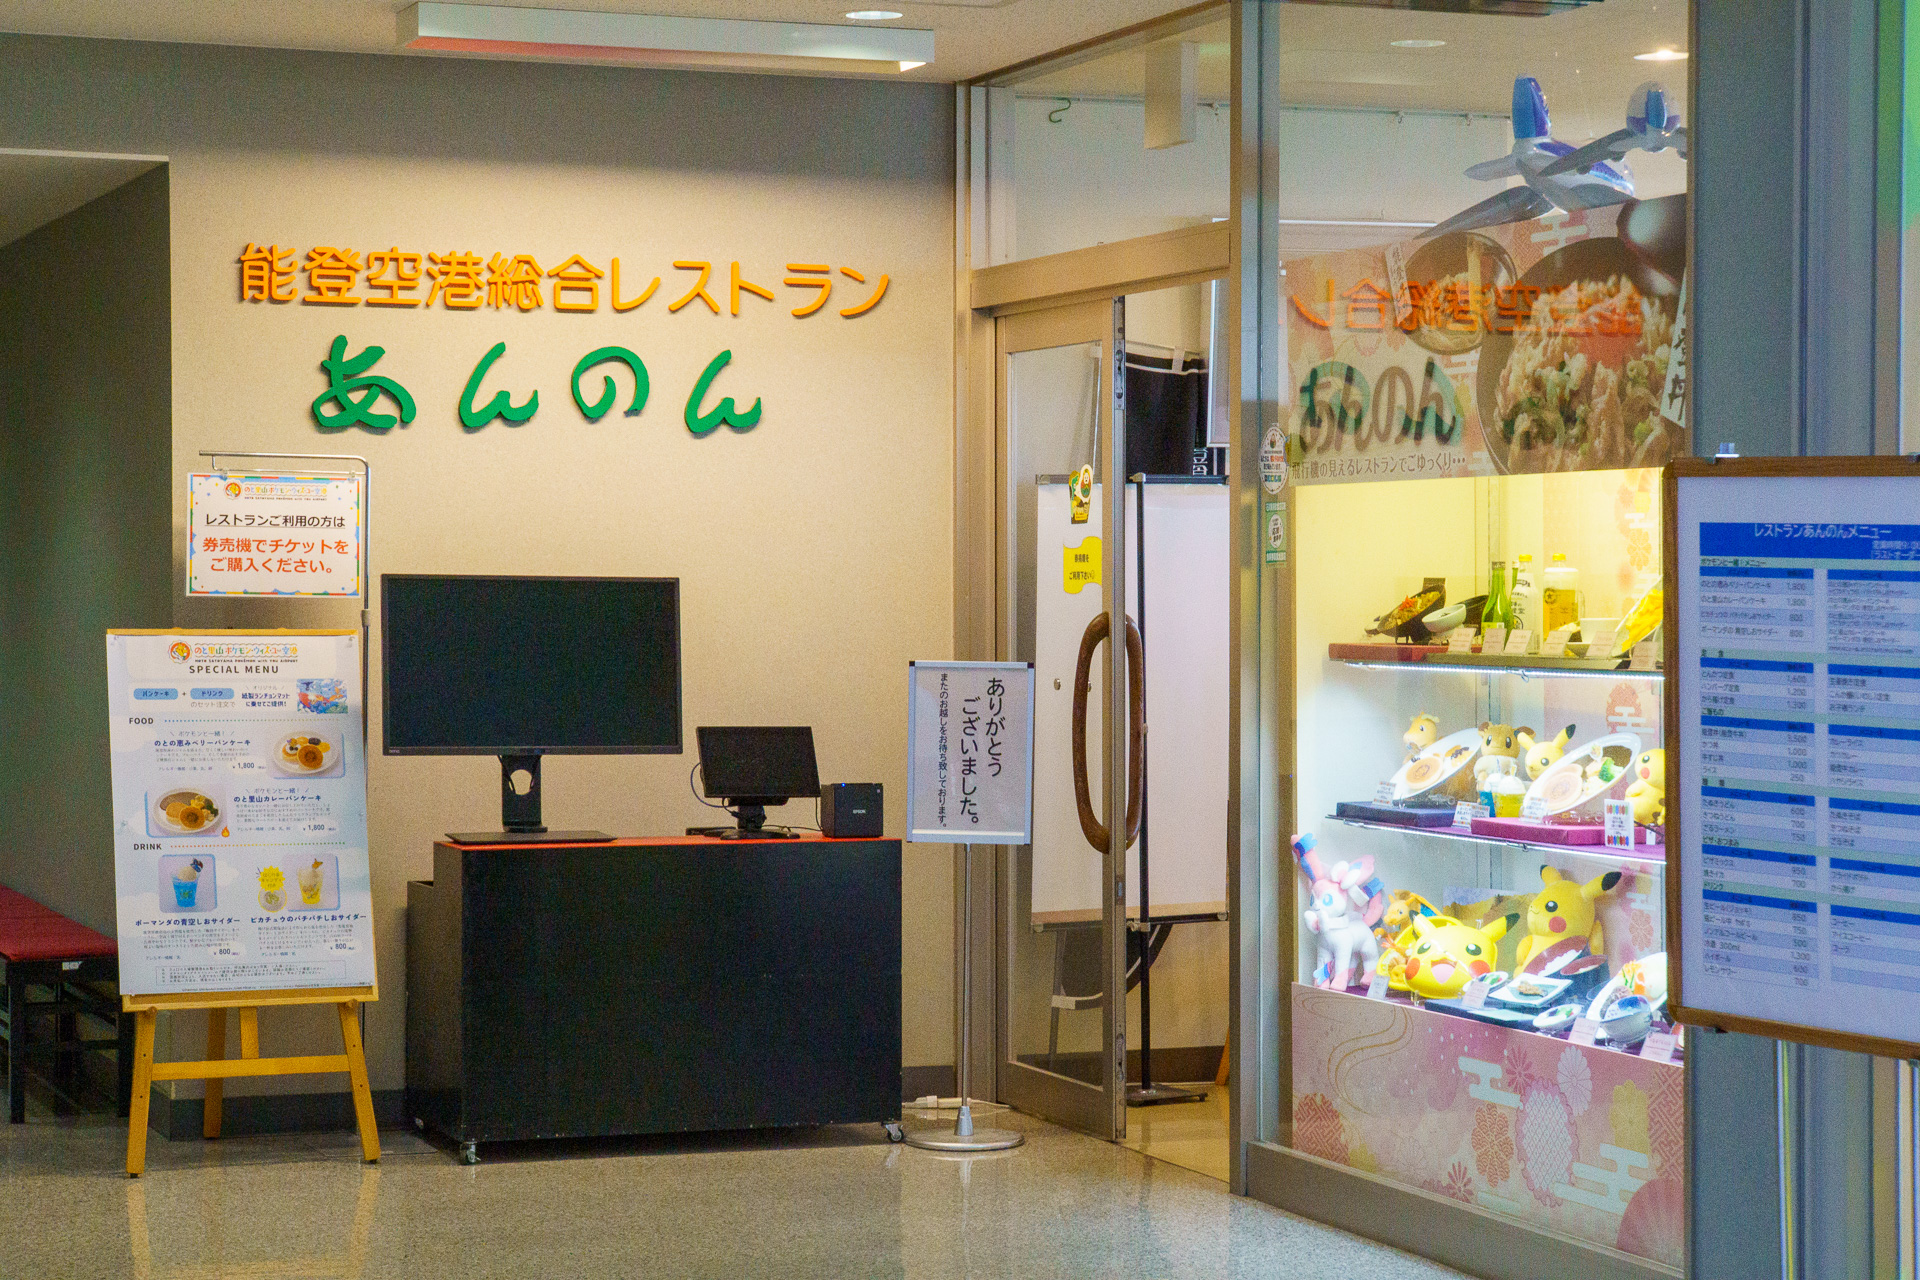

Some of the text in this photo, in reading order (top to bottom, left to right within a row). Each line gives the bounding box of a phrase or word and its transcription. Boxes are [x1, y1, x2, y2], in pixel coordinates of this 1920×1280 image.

[240, 242, 889, 318] 能登空港総合レストラン
[311, 334, 762, 434] あんのん
[205, 513, 346, 528] レストランご利用の方は
[202, 537, 349, 555] 券売機でチケットを
[210, 556, 332, 574] ご購入ください。
[189, 665, 279, 674] SPECIAL MENU
[129, 717, 154, 725] FOOD
[985, 677, 1006, 778] ありがとう
[237, 762, 255, 771] 1,800
[960, 696, 981, 824] ございました。
[308, 824, 325, 832] 1,800
[133, 843, 162, 851] DRINK
